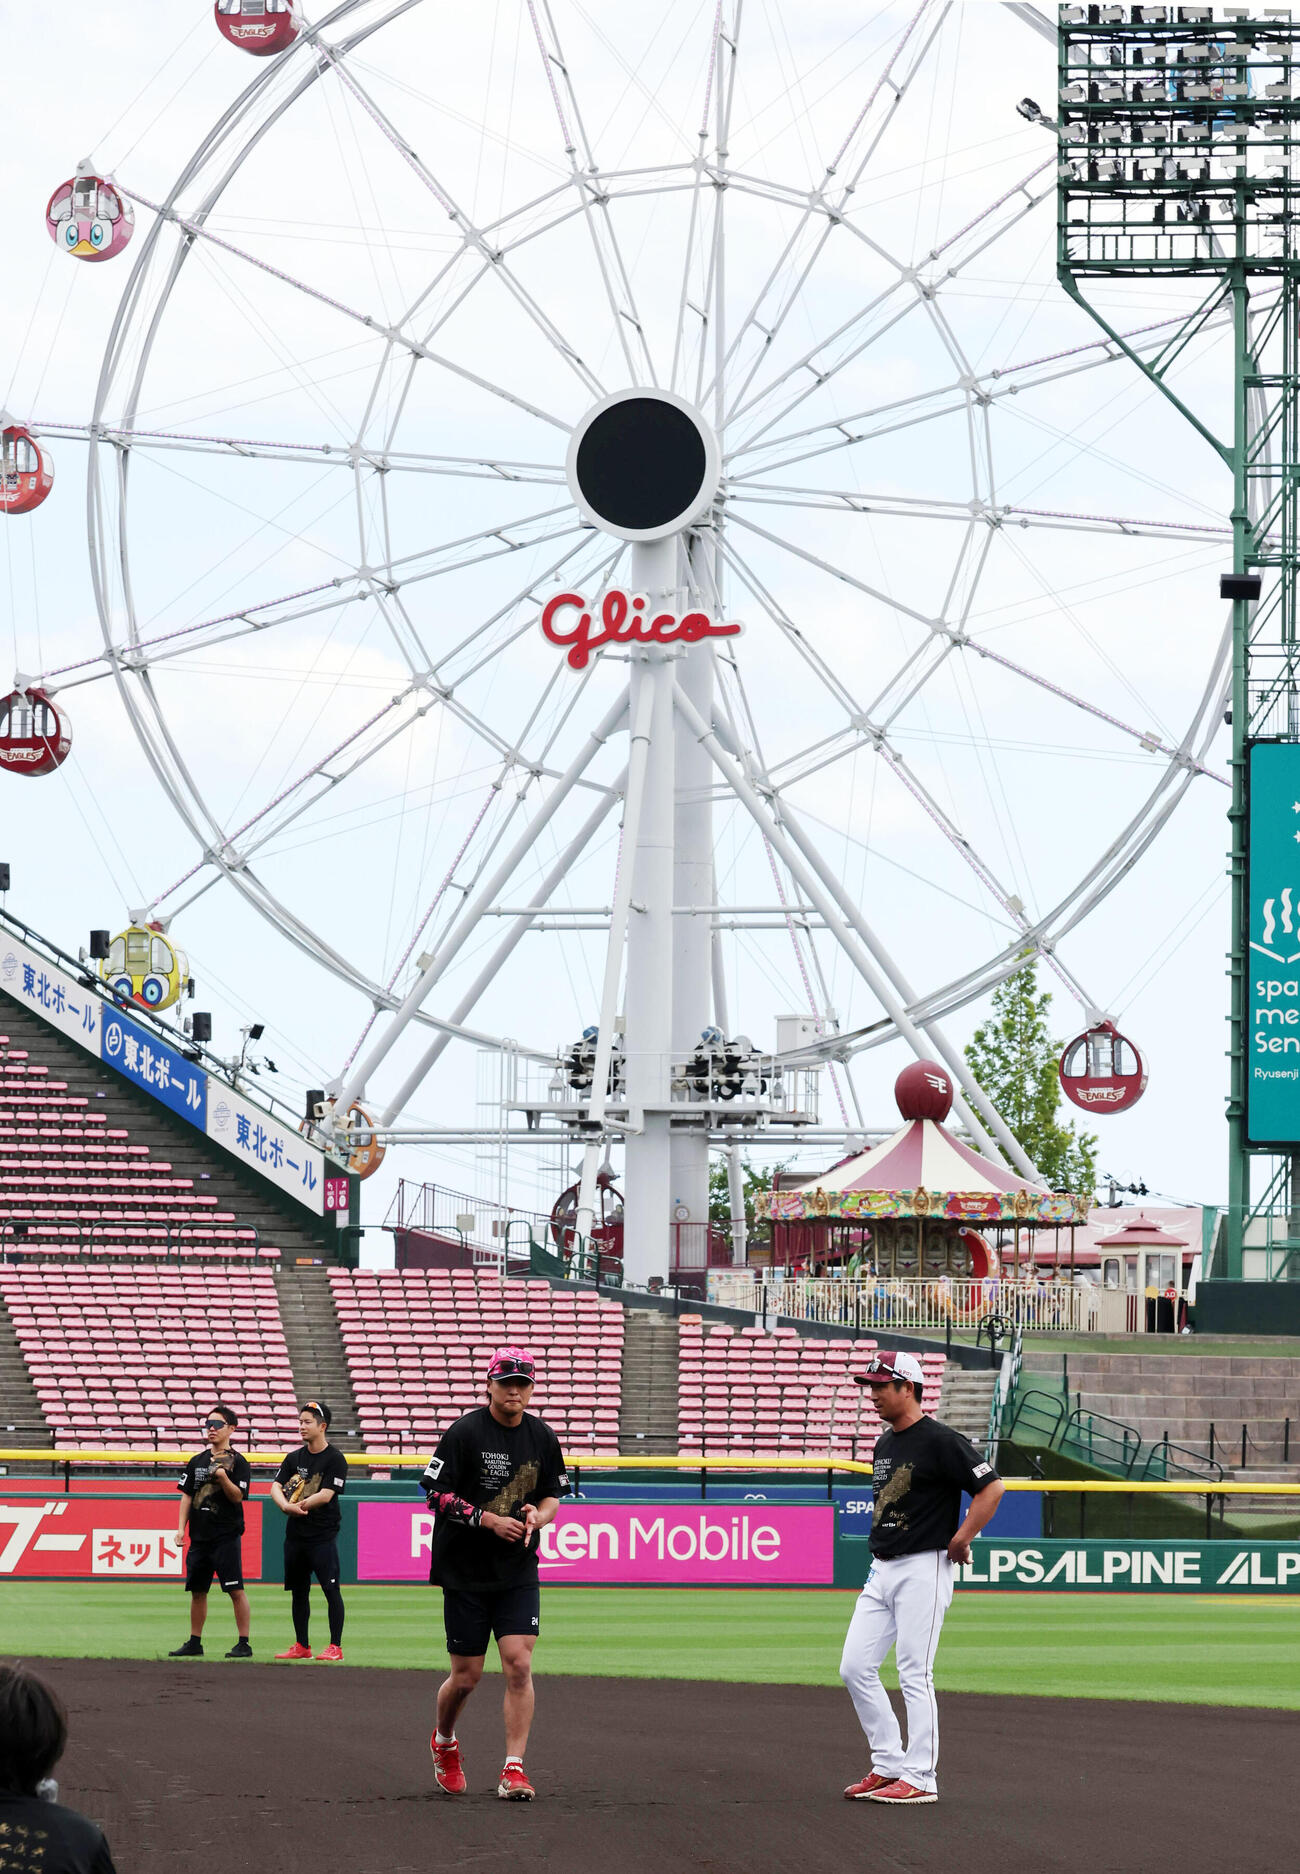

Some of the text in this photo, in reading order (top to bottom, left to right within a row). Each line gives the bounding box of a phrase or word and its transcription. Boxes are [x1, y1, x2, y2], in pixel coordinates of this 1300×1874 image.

[1256, 980, 1299, 1002] spa
[123, 1034, 201, 1111] 東北ポール
[97, 1535, 177, 1568] ネット
[630, 1515, 781, 1561] Mobile
